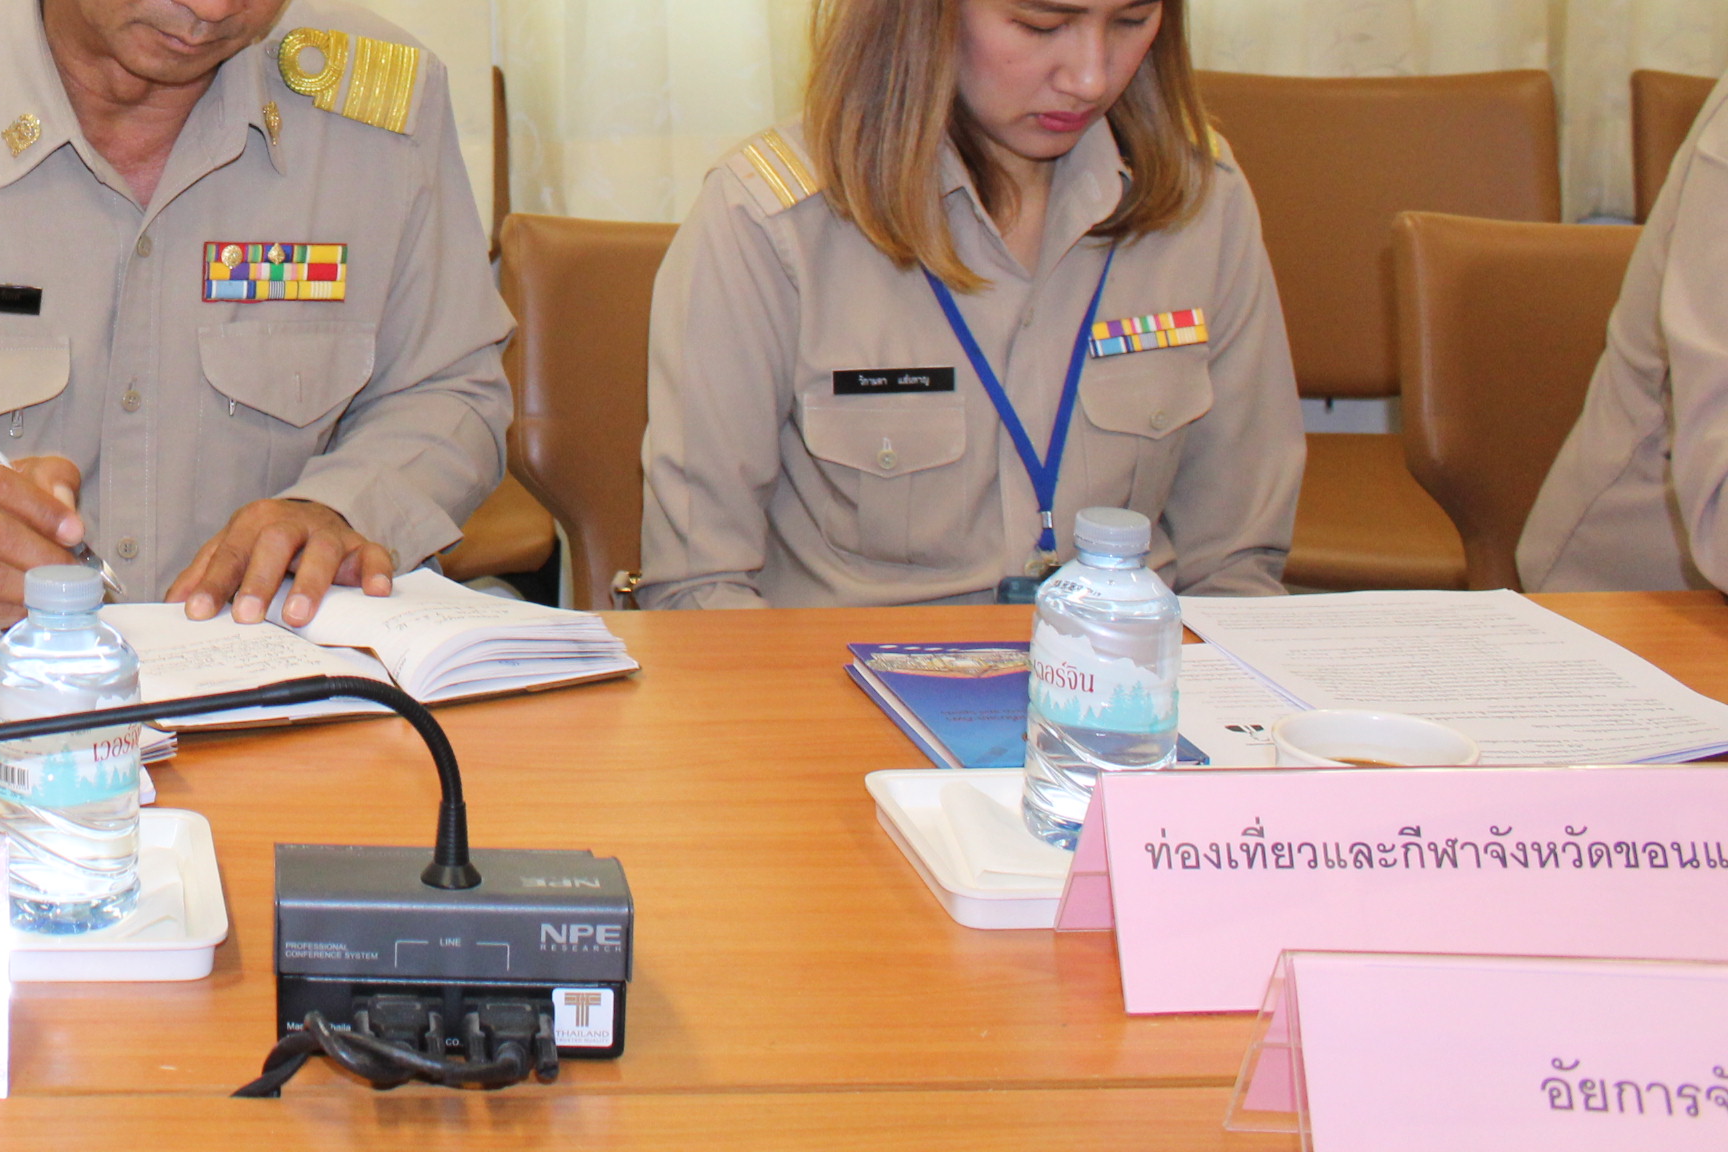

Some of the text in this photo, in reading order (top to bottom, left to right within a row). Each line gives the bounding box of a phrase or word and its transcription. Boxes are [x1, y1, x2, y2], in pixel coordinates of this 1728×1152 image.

[540, 923, 622, 945] NPE
[285, 941, 348, 951] PROFESSIONAL
[440, 937, 462, 947] LINE
[540, 944, 622, 953] RESEARCH
[285, 950, 379, 960] CONFERENCE SYSTEM
[556, 1030, 610, 1038] THAILAND
